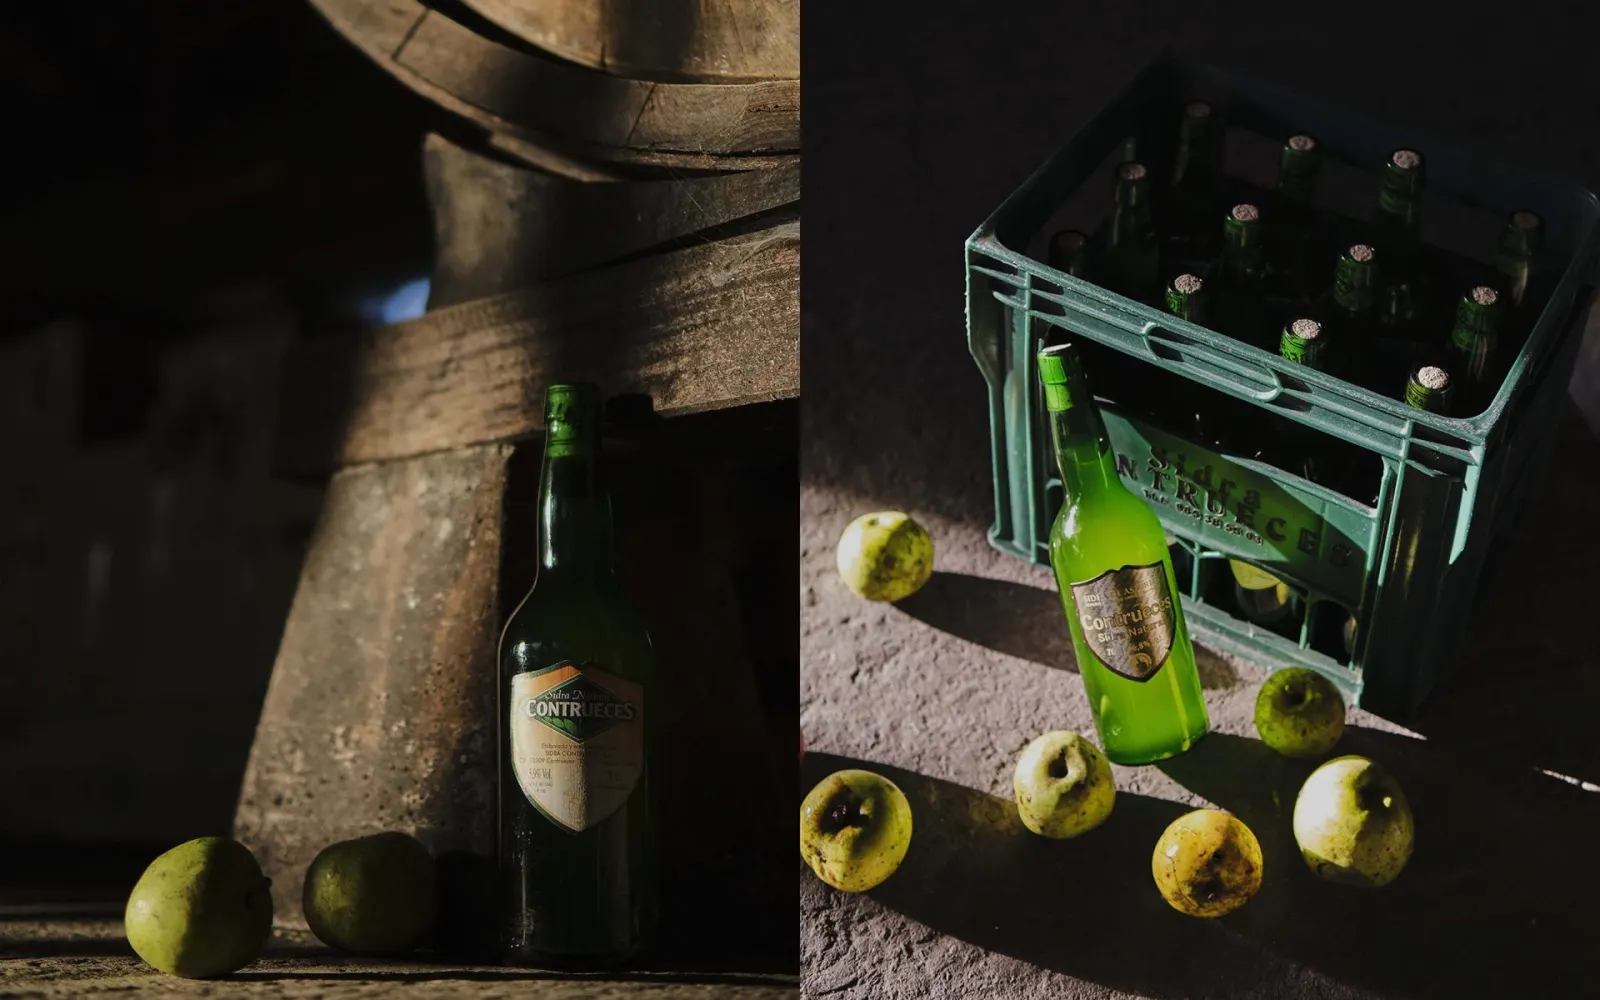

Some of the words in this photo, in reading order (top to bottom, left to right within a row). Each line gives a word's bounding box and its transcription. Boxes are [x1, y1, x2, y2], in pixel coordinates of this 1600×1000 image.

[1147, 446, 1261, 509] Sidra
[1117, 453, 1351, 569] NTRUECES
[525, 699, 634, 719] CONTRUECES
[545, 690, 570, 699] Sidra
